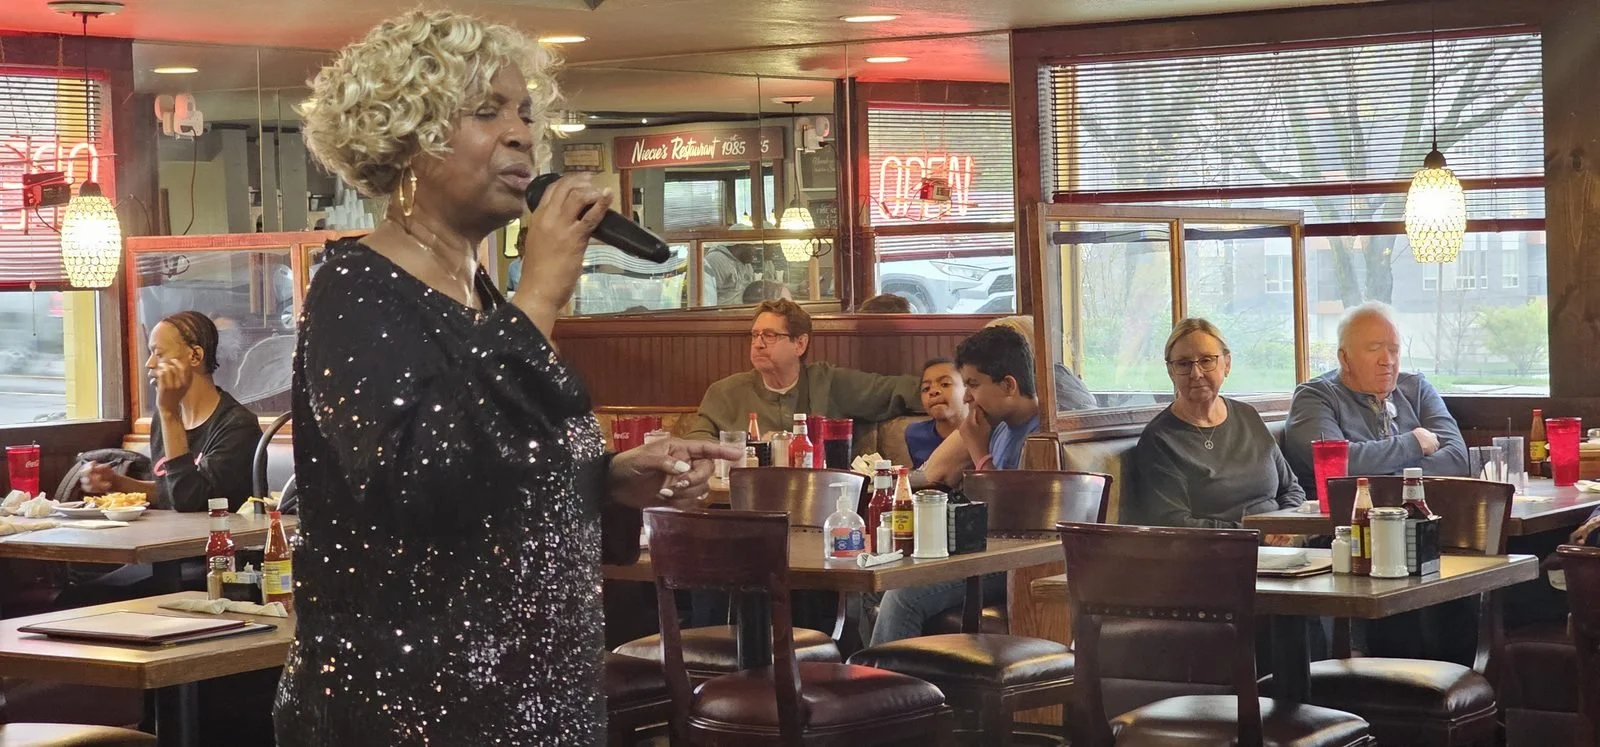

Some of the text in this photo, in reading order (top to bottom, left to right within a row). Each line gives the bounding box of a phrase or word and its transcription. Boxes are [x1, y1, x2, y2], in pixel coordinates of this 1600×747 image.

[671, 136, 720, 160] Restaurant
[722, 141, 746, 156] 1985
[879, 156, 972, 219] OPEN
